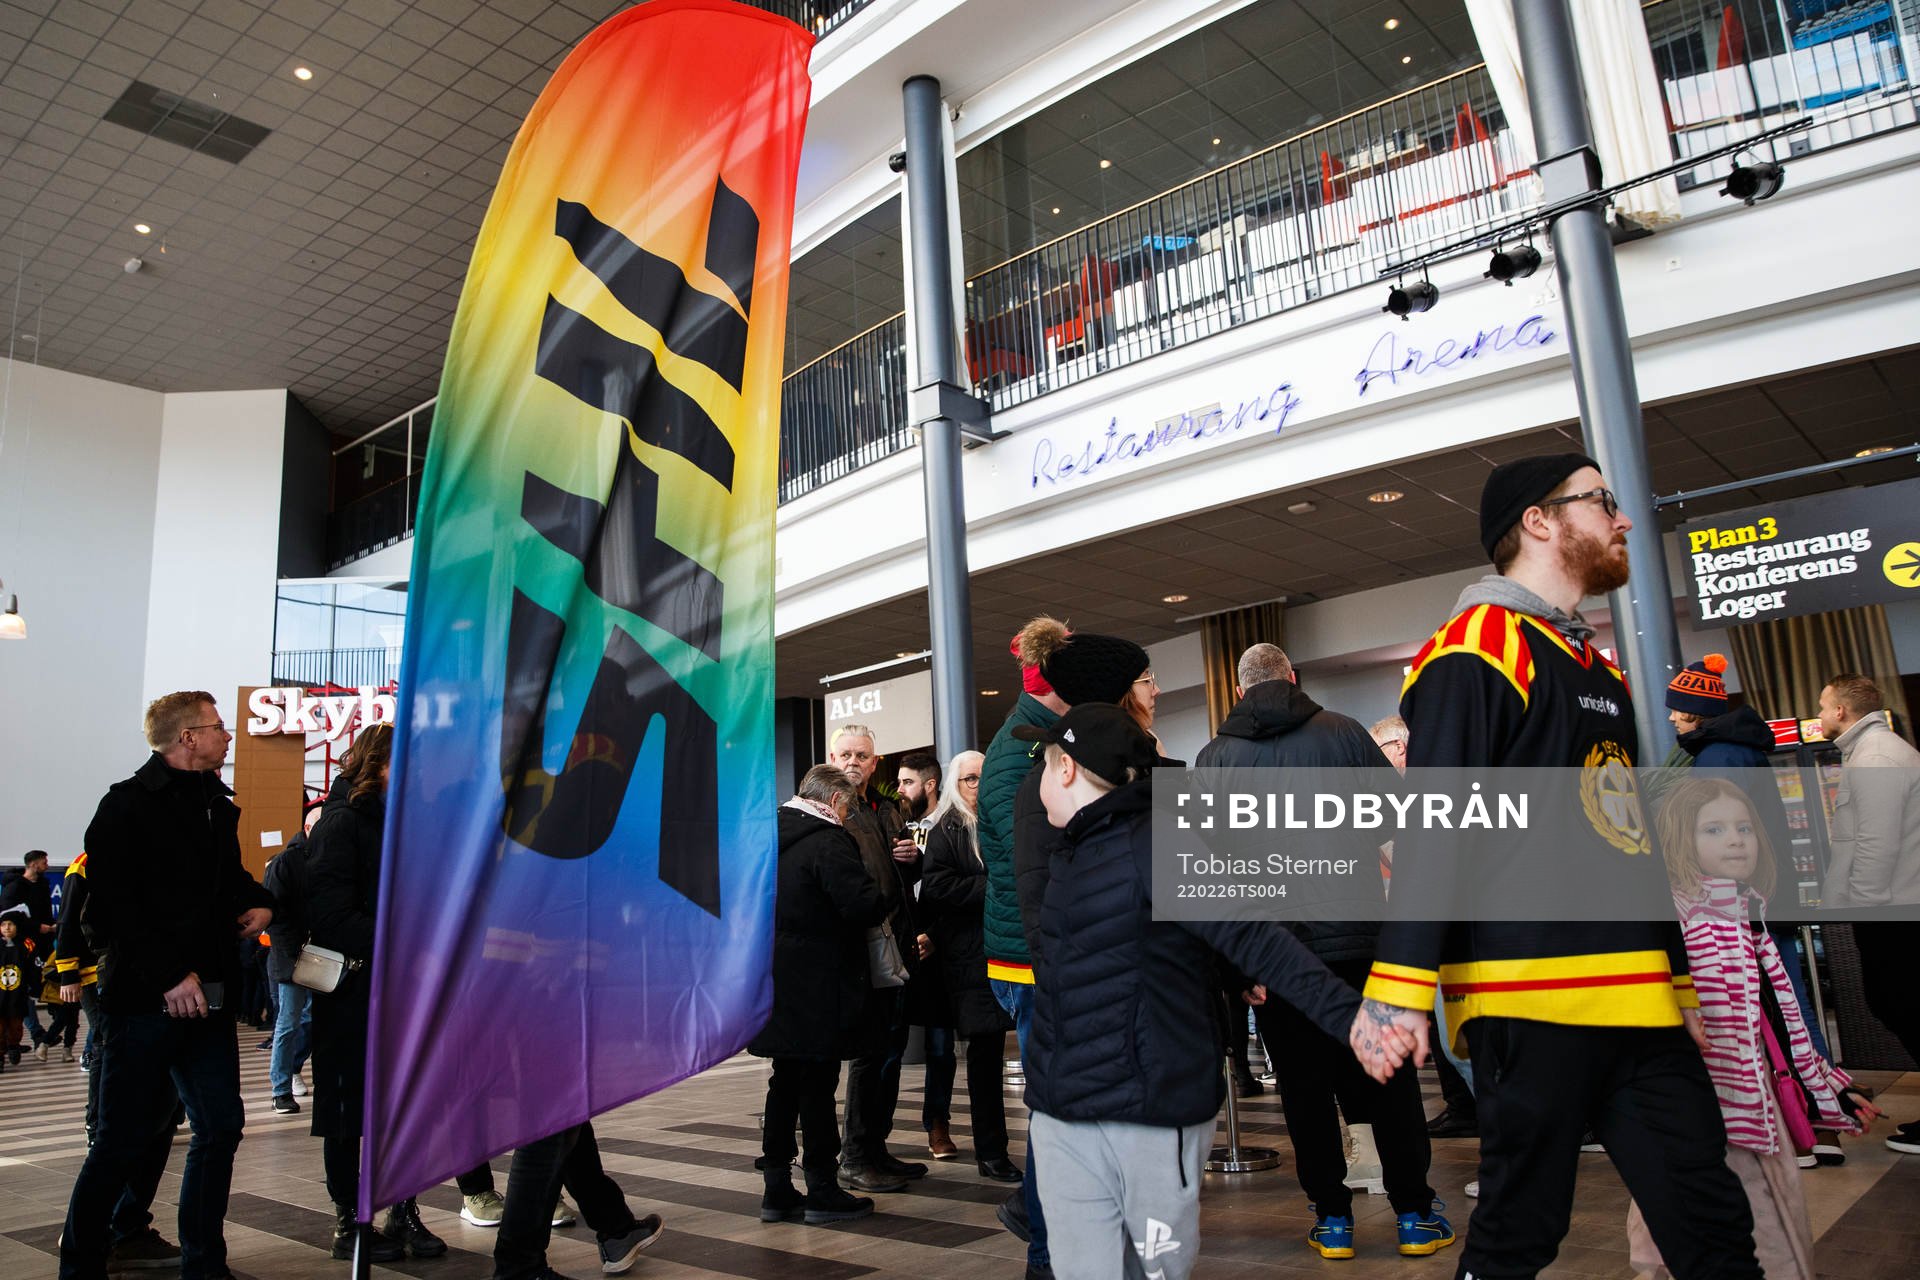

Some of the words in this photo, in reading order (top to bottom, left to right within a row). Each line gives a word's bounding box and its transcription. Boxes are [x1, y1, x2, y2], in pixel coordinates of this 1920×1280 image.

[1031, 381, 1301, 488] Restaurang
[1354, 314, 1555, 396] Arena
[1692, 528, 1872, 575] Restaurang
[1696, 555, 1858, 597] Konferens
[1699, 590, 1787, 619] Loger
[829, 689, 882, 720] A1-G1
[1578, 694, 1606, 714] unicef
